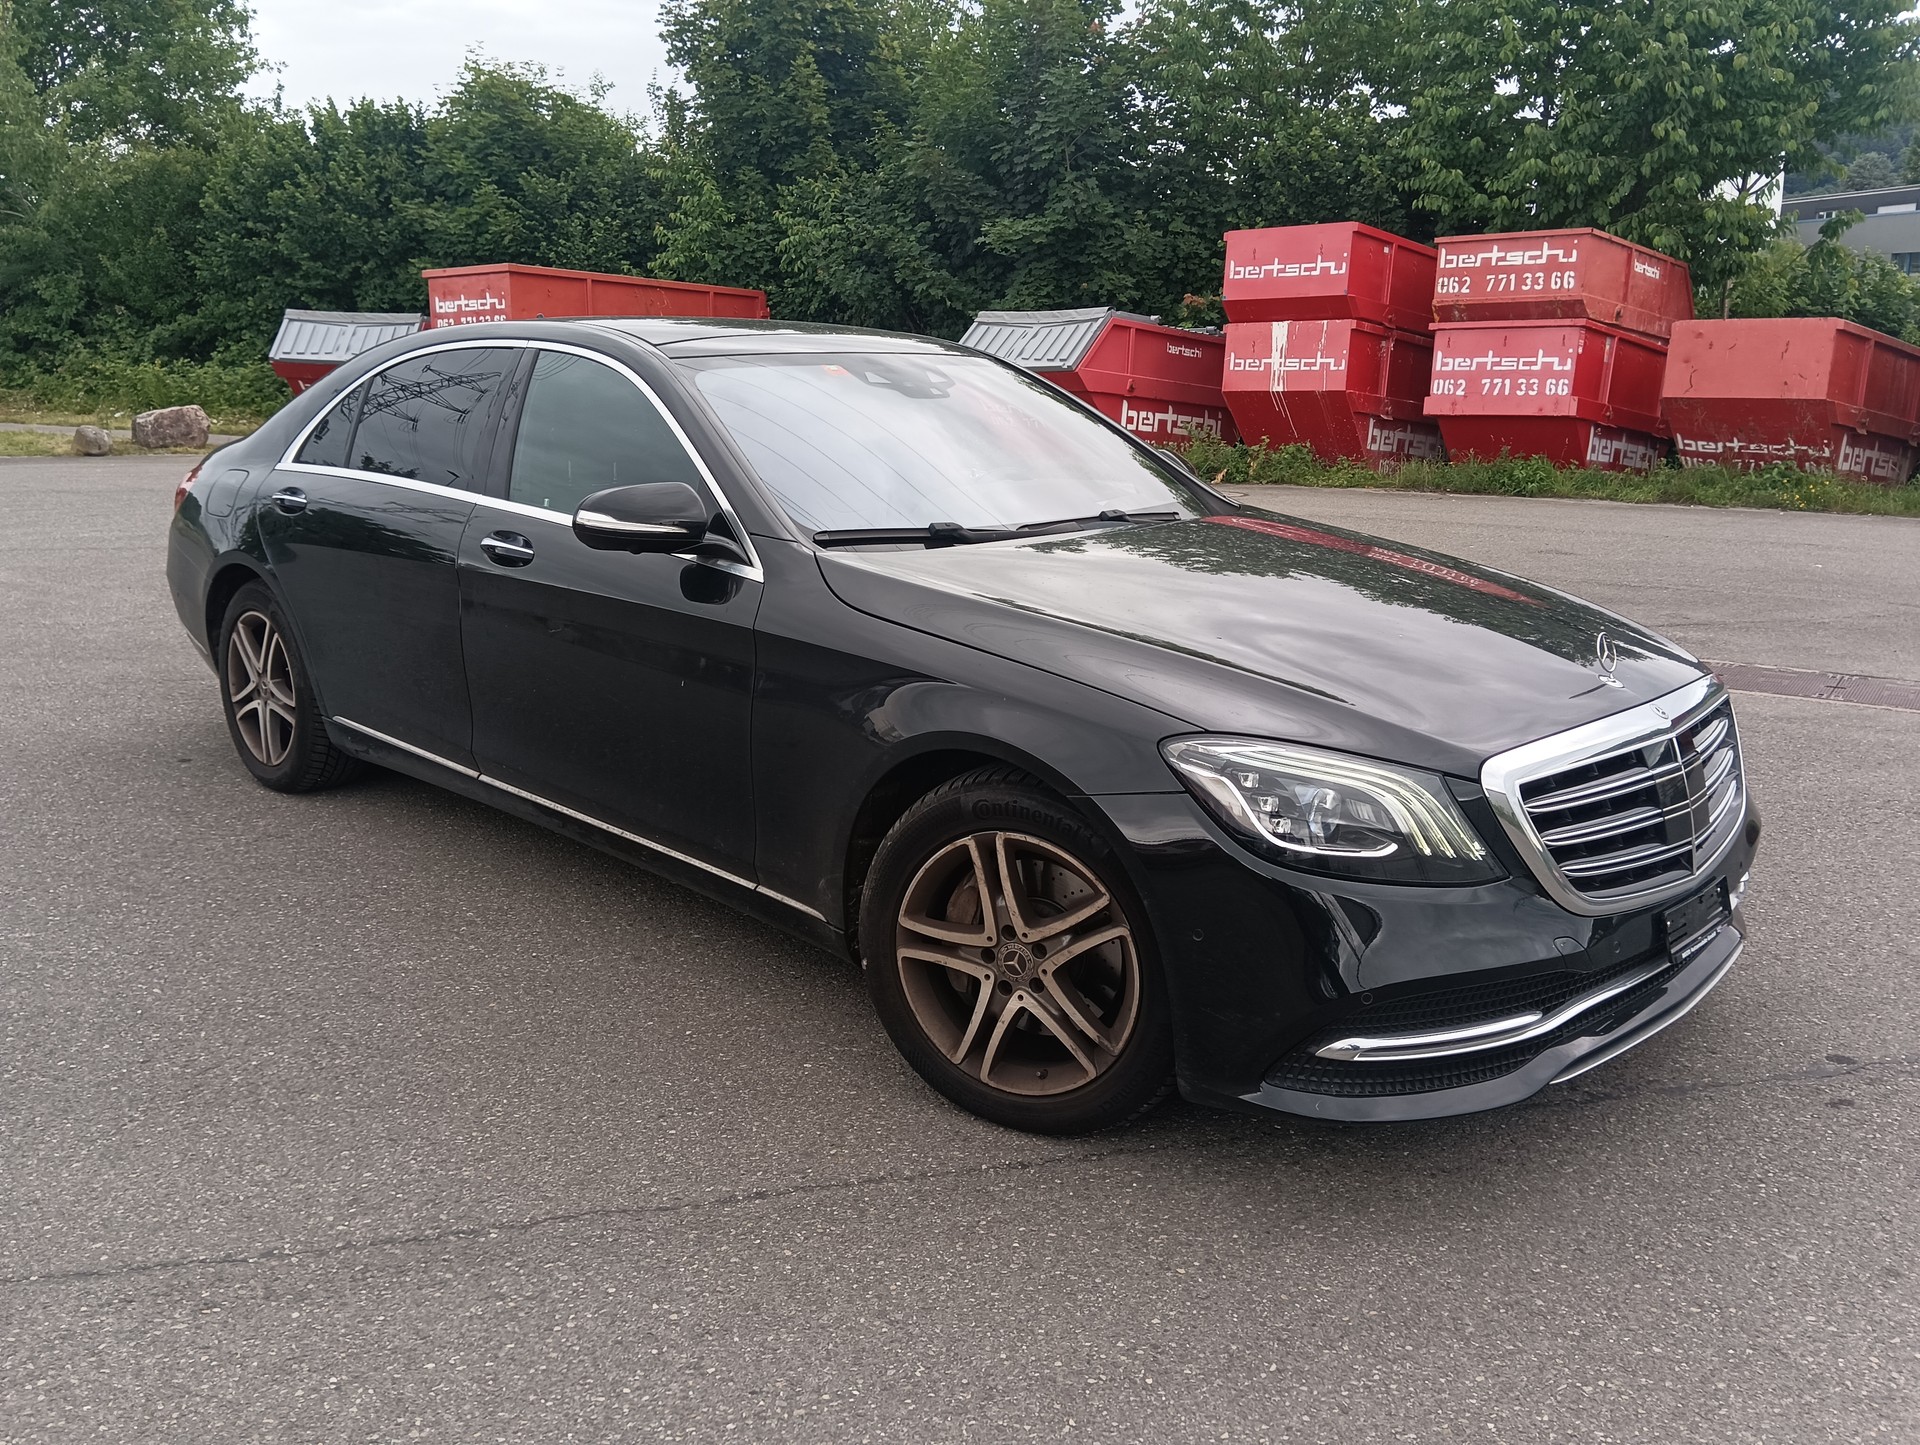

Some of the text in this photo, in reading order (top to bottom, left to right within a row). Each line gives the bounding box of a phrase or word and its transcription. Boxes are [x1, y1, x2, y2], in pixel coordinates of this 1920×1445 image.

[1229, 252, 1348, 279] bertschi
[1439, 239, 1578, 269] bertschi
[1437, 270, 1575, 293] 062 771 33 66
[435, 291, 505, 313] bertschi
[1166, 342, 1202, 358] bertschi
[1229, 350, 1348, 371] bertschi
[1435, 348, 1574, 371] bertschi
[1432, 378, 1569, 396] 062 771 33 66
[972, 799, 1084, 838] Continental
